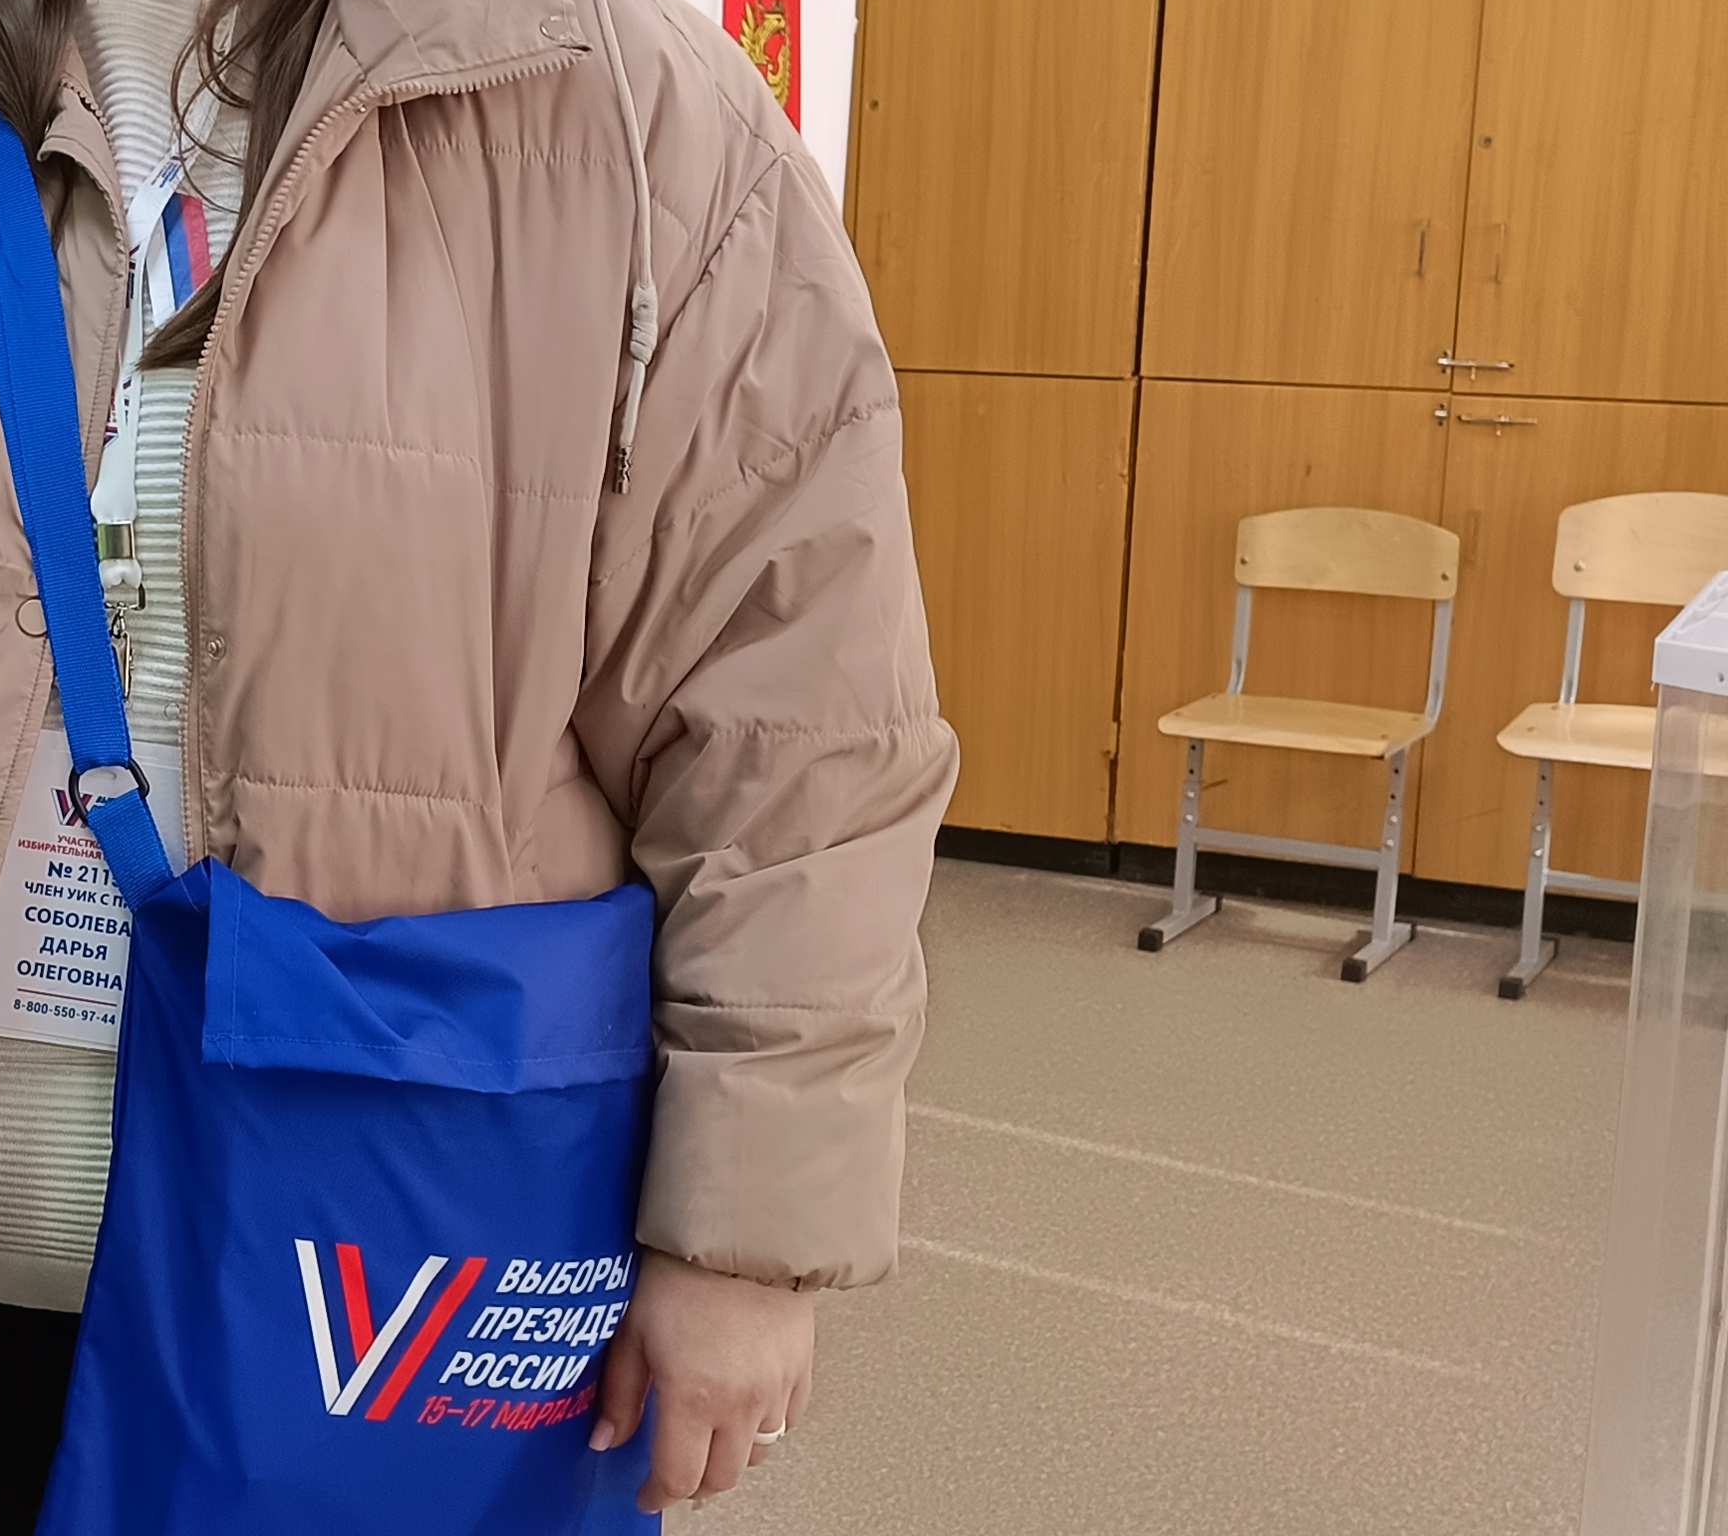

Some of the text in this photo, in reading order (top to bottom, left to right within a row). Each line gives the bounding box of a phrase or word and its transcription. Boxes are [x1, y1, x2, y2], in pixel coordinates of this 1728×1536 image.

[17, 839, 102, 860] ИЗБИРАТЕЛЬНАЯ
[57, 835, 101, 850] УЧАСТК
[47, 861, 73, 879] №
[24, 881, 64, 899] ЧЛЕН
[67, 887, 97, 904] УИК
[24, 906, 131, 937] СОБОЛЕВА
[39, 936, 108, 961] ДАРЬЯ
[17, 959, 123, 991] ОЛЕГОВНА
[13, 998, 116, 1025] 8-800-550-97-44
[496, 1251, 634, 1295] ВЫБОРЫ
[467, 1300, 630, 1347] ПРЕЗИДЕ
[439, 1350, 590, 1391] РОССИИ
[491, 1397, 572, 1431] МАРТА
